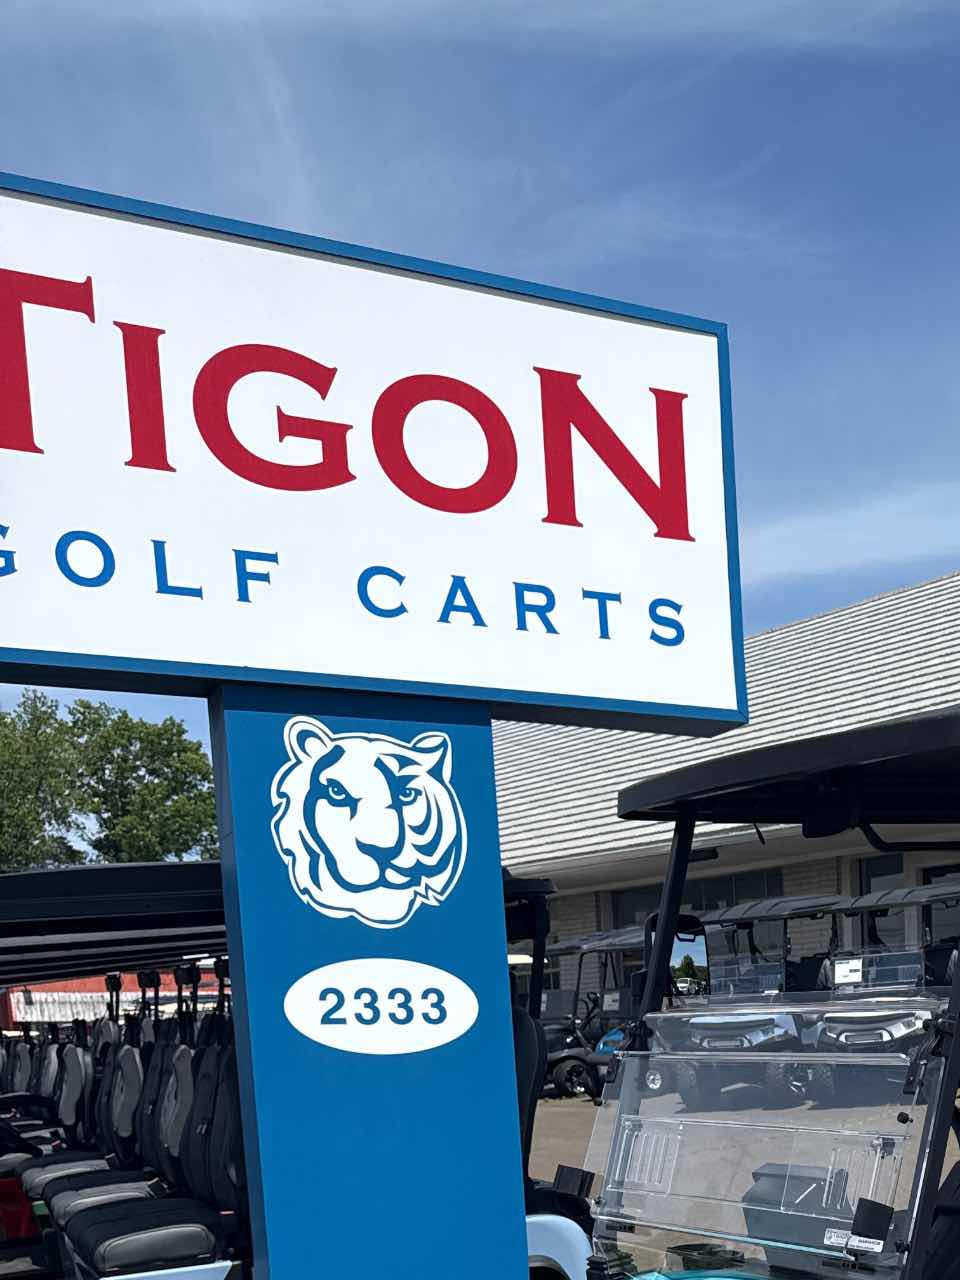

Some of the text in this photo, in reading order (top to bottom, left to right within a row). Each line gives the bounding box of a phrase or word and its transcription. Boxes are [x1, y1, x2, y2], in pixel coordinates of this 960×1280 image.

[0, 524, 686, 647] OLF CARTS
[318, 986, 448, 1025] 2333
